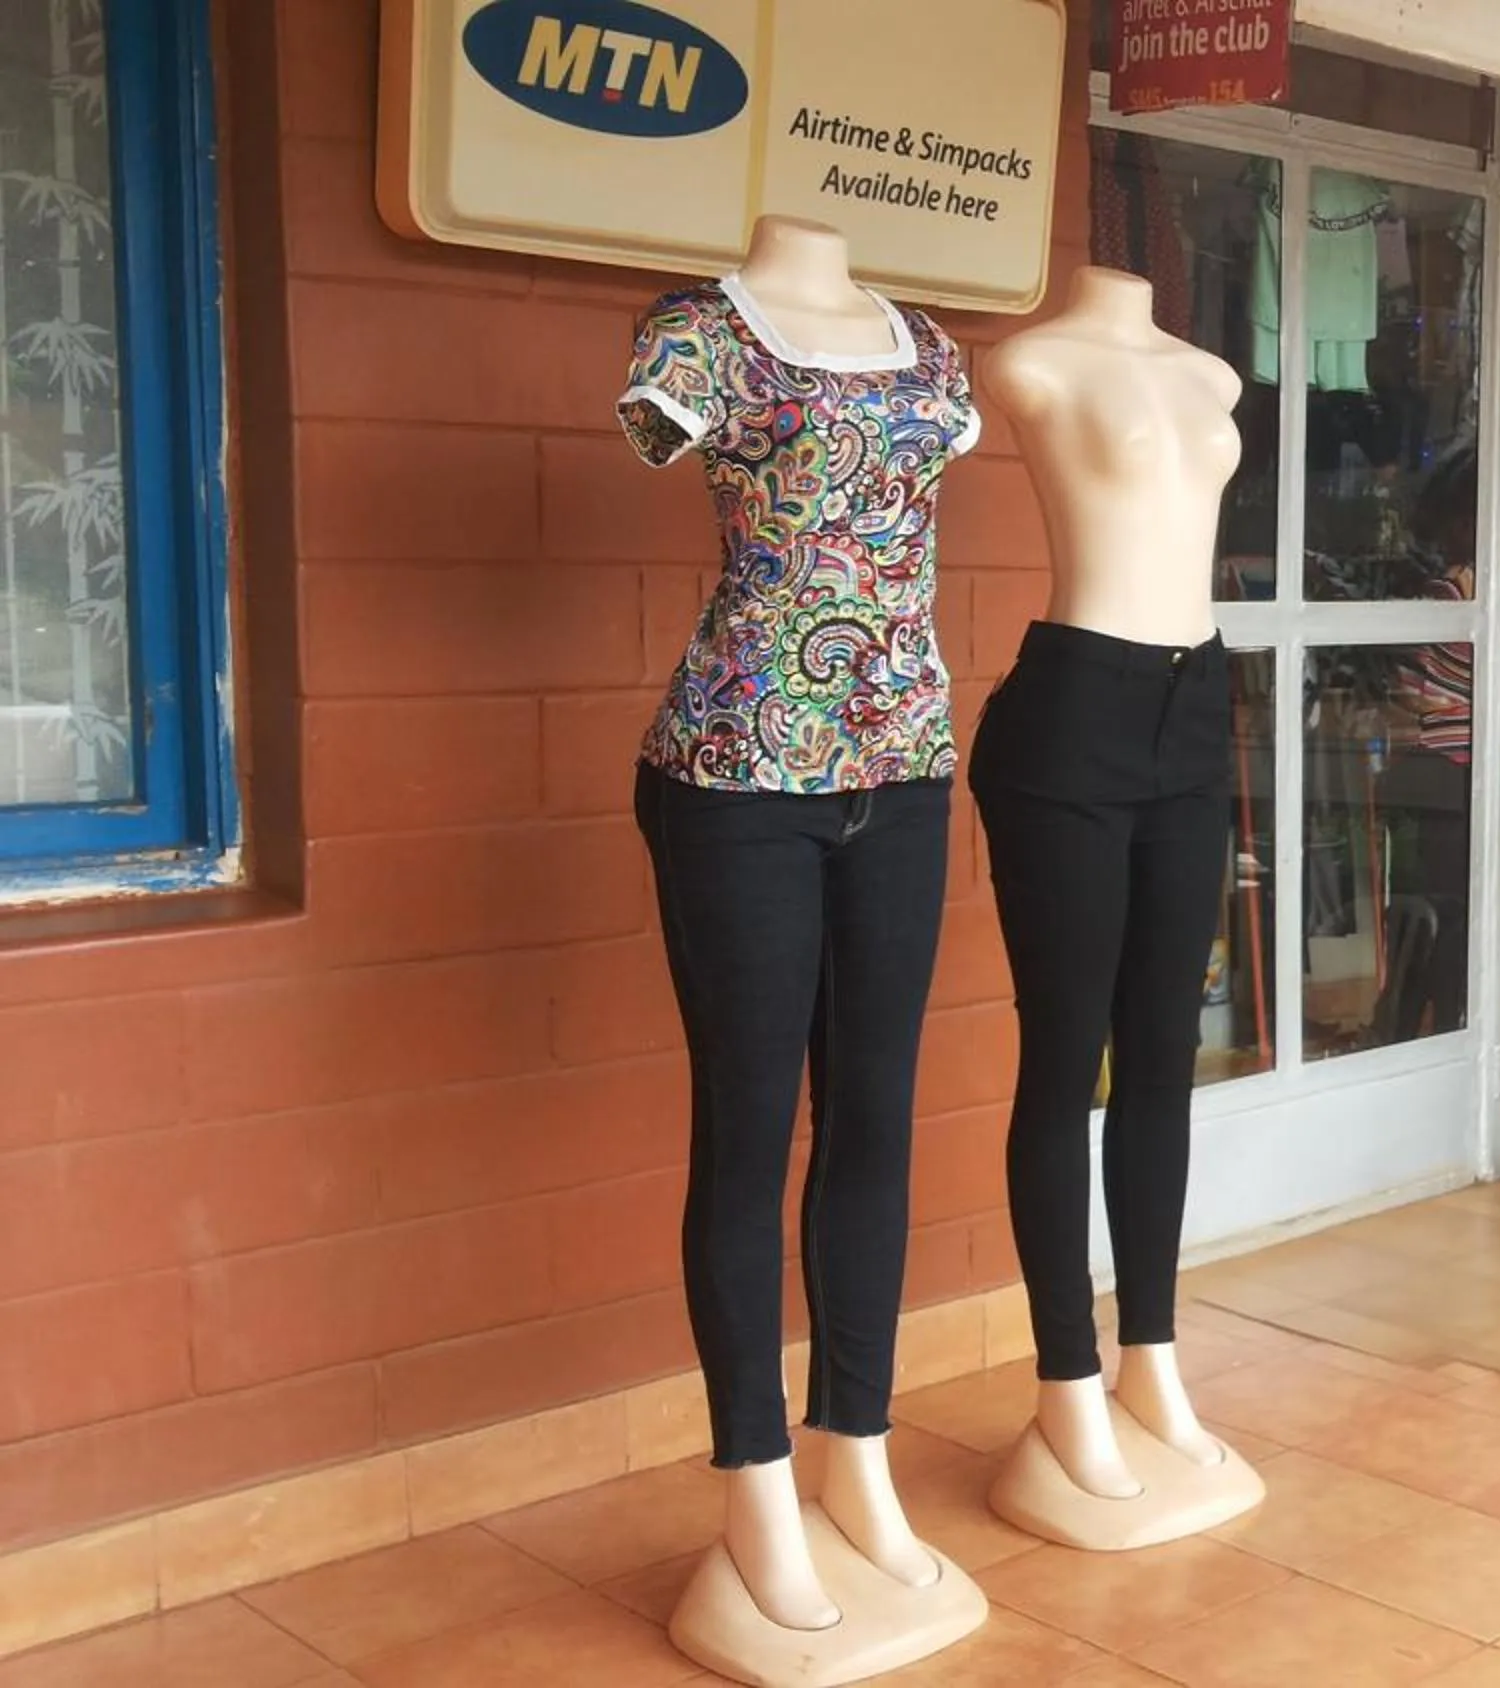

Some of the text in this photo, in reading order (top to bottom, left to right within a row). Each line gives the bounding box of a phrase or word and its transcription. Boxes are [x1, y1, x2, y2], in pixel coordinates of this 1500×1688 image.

[1194, 0, 1273, 13] Arse
[517, 15, 703, 113] MTN
[1117, 13, 1270, 73] join the club
[788, 107, 1033, 180] Airtime & Simpacks
[819, 164, 999, 222] Available here
